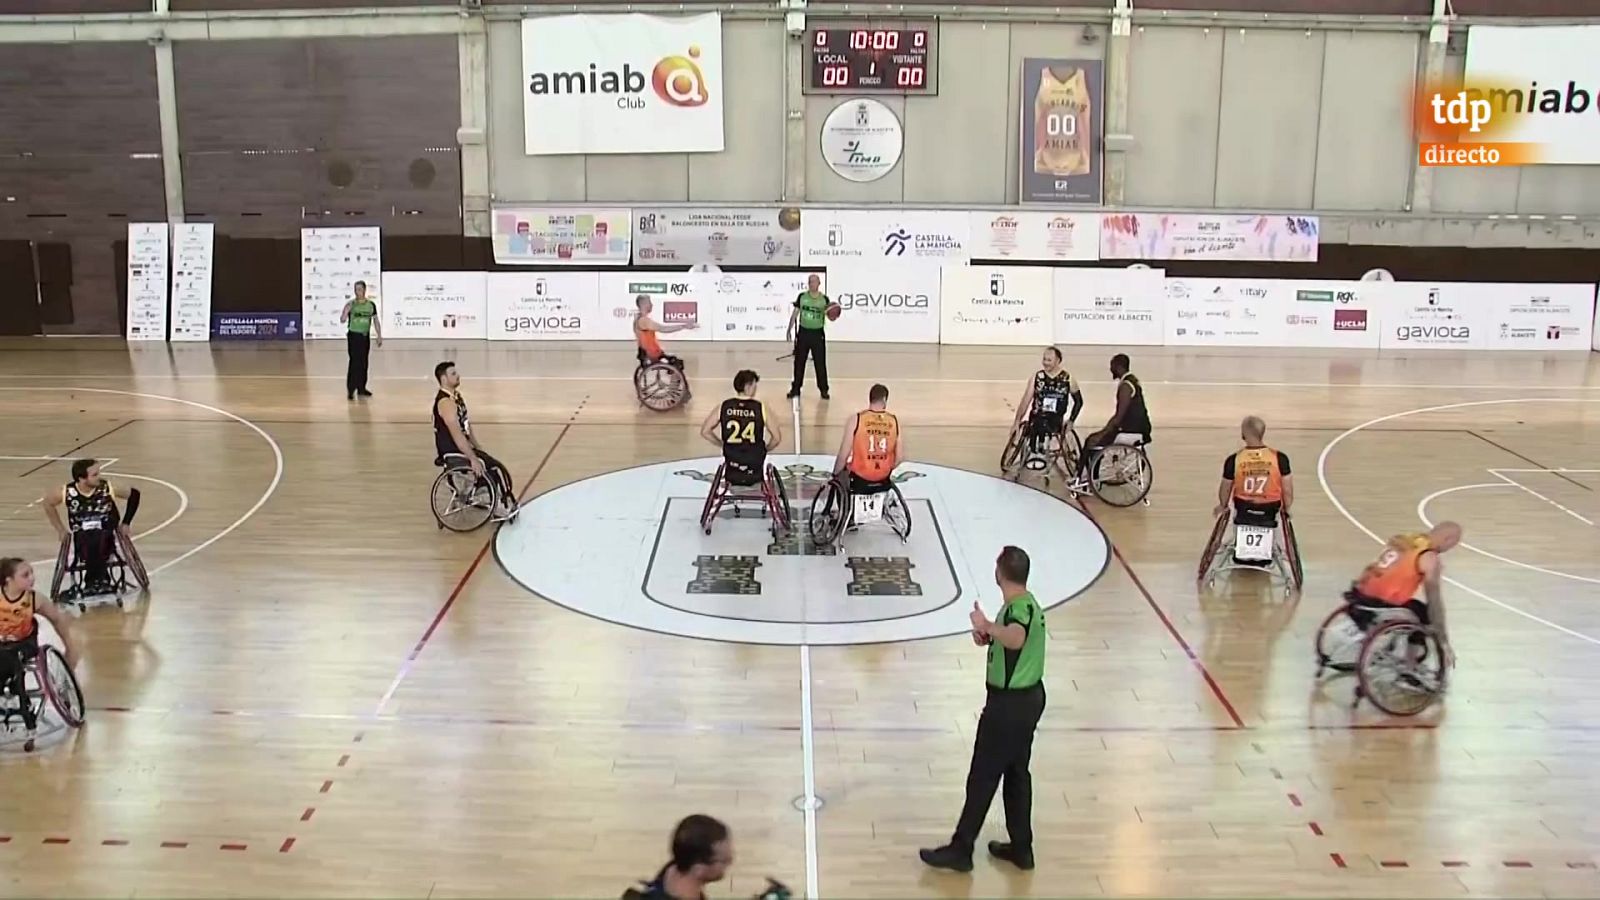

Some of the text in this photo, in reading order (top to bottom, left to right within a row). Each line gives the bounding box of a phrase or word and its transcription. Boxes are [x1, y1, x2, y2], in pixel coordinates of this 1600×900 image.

[816, 31, 827, 46] 0
[850, 31, 899, 49] 10:00
[914, 32, 924, 46] 0
[818, 54, 848, 64] LOCAL
[892, 55, 923, 64] VISITANTE
[530, 63, 645, 94] amiab
[823, 67, 848, 85] 00
[898, 67, 923, 85] 00
[617, 97, 646, 109] Club
[1046, 113, 1076, 136] 00
[927, 242, 963, 250] MANCHA
[838, 293, 928, 310] gaviota
[670, 312, 697, 320] UCLM
[505, 316, 581, 332] gaviota
[1341, 320, 1365, 328] UCLM
[1397, 326, 1470, 341] gaviota
[726, 408, 756, 418] ORTEGA
[726, 419, 756, 444] 24
[868, 435, 888, 453] 14
[1243, 476, 1268, 494] 07
[862, 501, 875, 512] 14
[1246, 534, 1264, 547] 07
